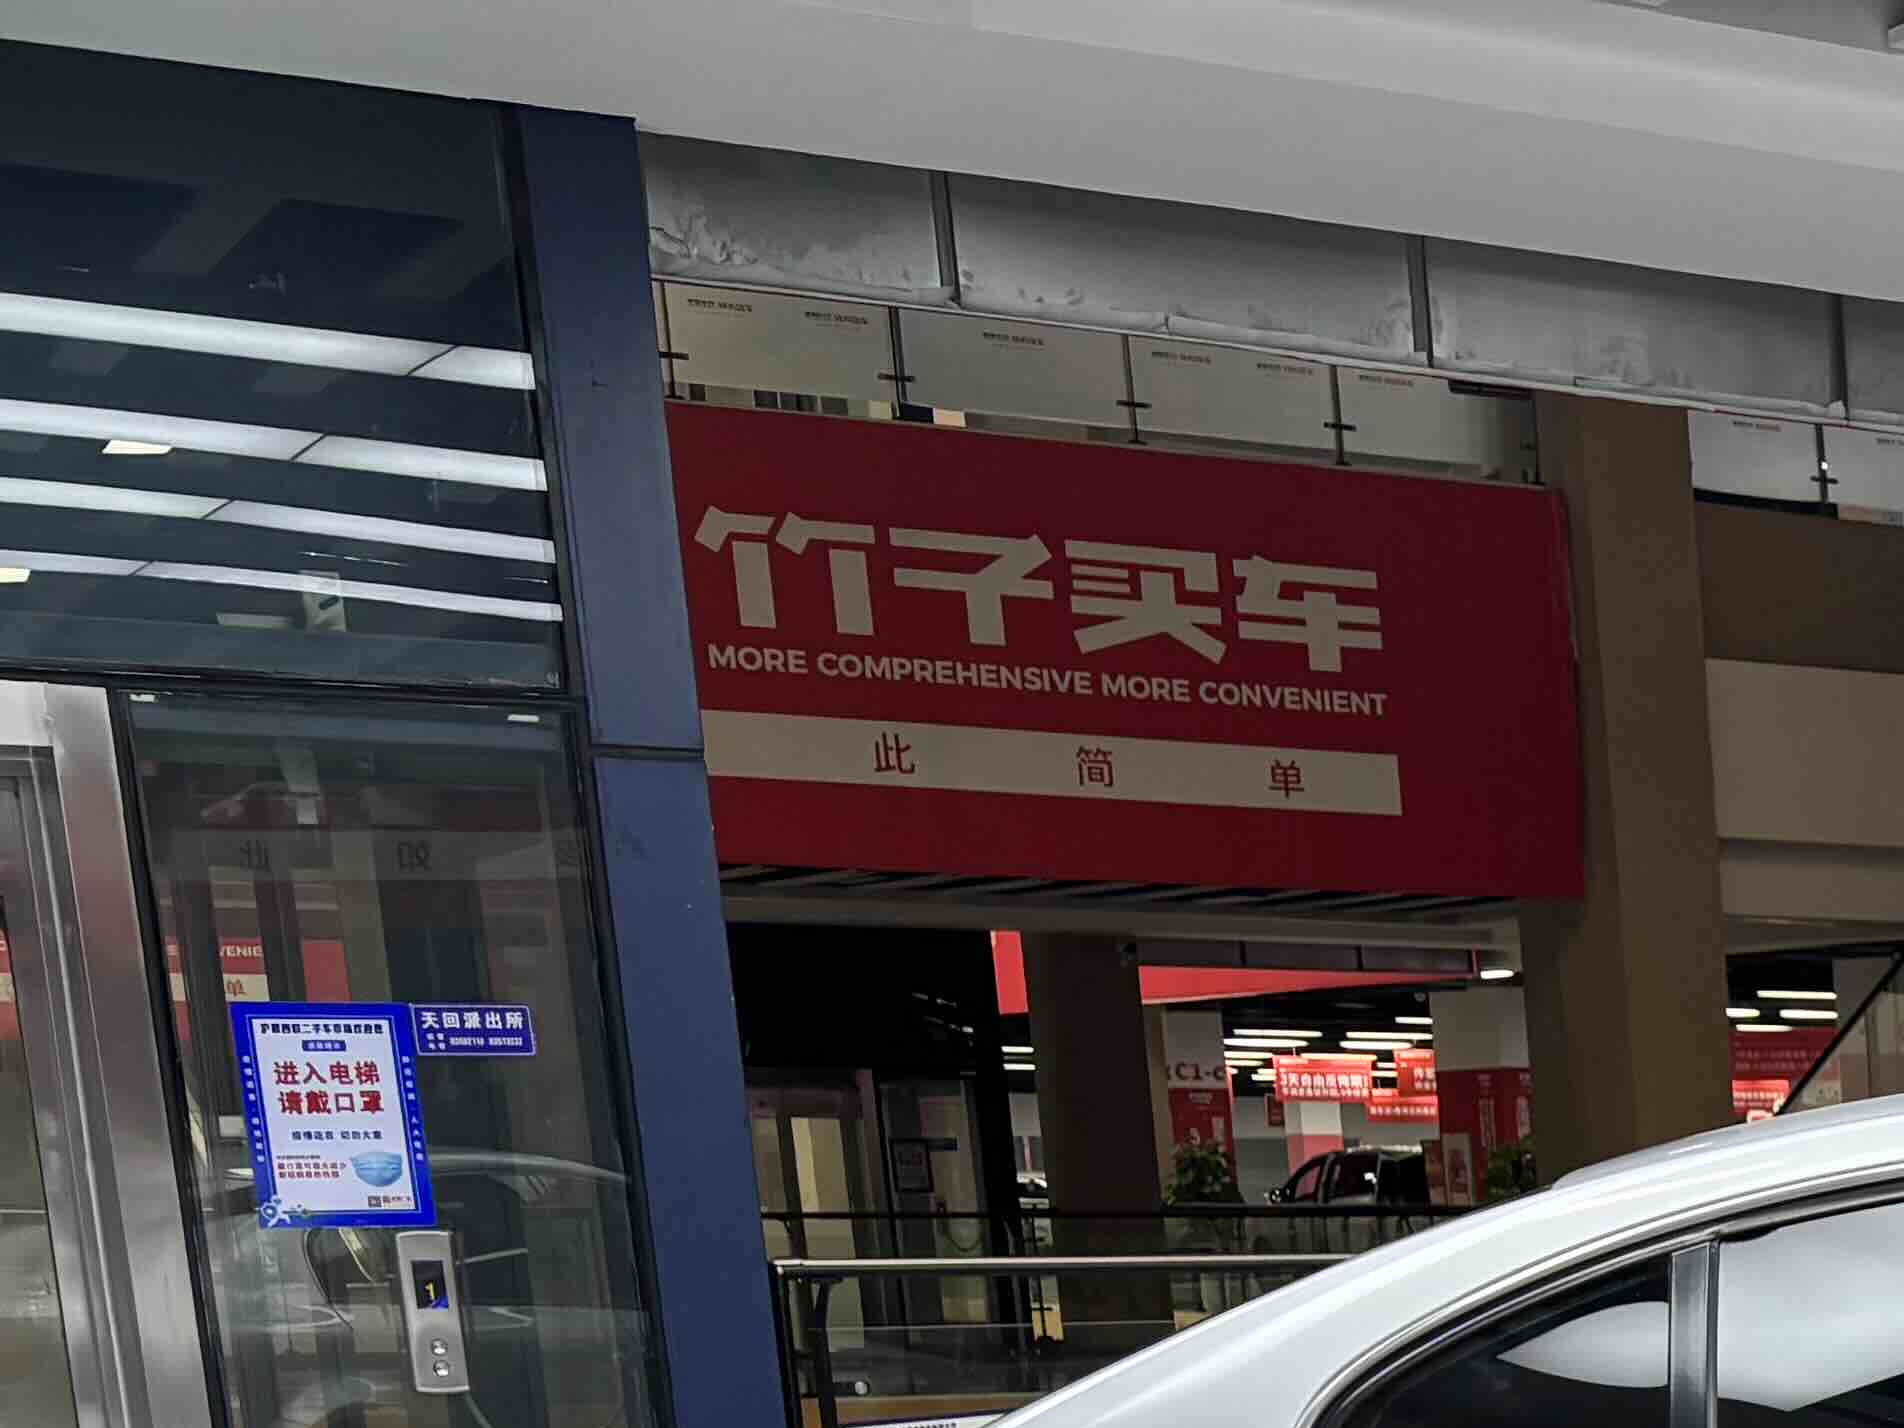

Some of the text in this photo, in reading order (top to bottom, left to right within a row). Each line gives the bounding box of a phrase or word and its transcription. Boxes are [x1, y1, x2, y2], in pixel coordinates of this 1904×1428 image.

[694, 506, 1382, 672] 竹子买车
[708, 643, 1387, 716] MORE COMPREHENSIVE MORE CONVENIENT
[872, 731, 1304, 800] 此 简 单
[421, 1011, 523, 1029] 天回派出所
[273, 1060, 381, 1085] 进入电梯
[278, 1090, 384, 1114] 请戴口罩
